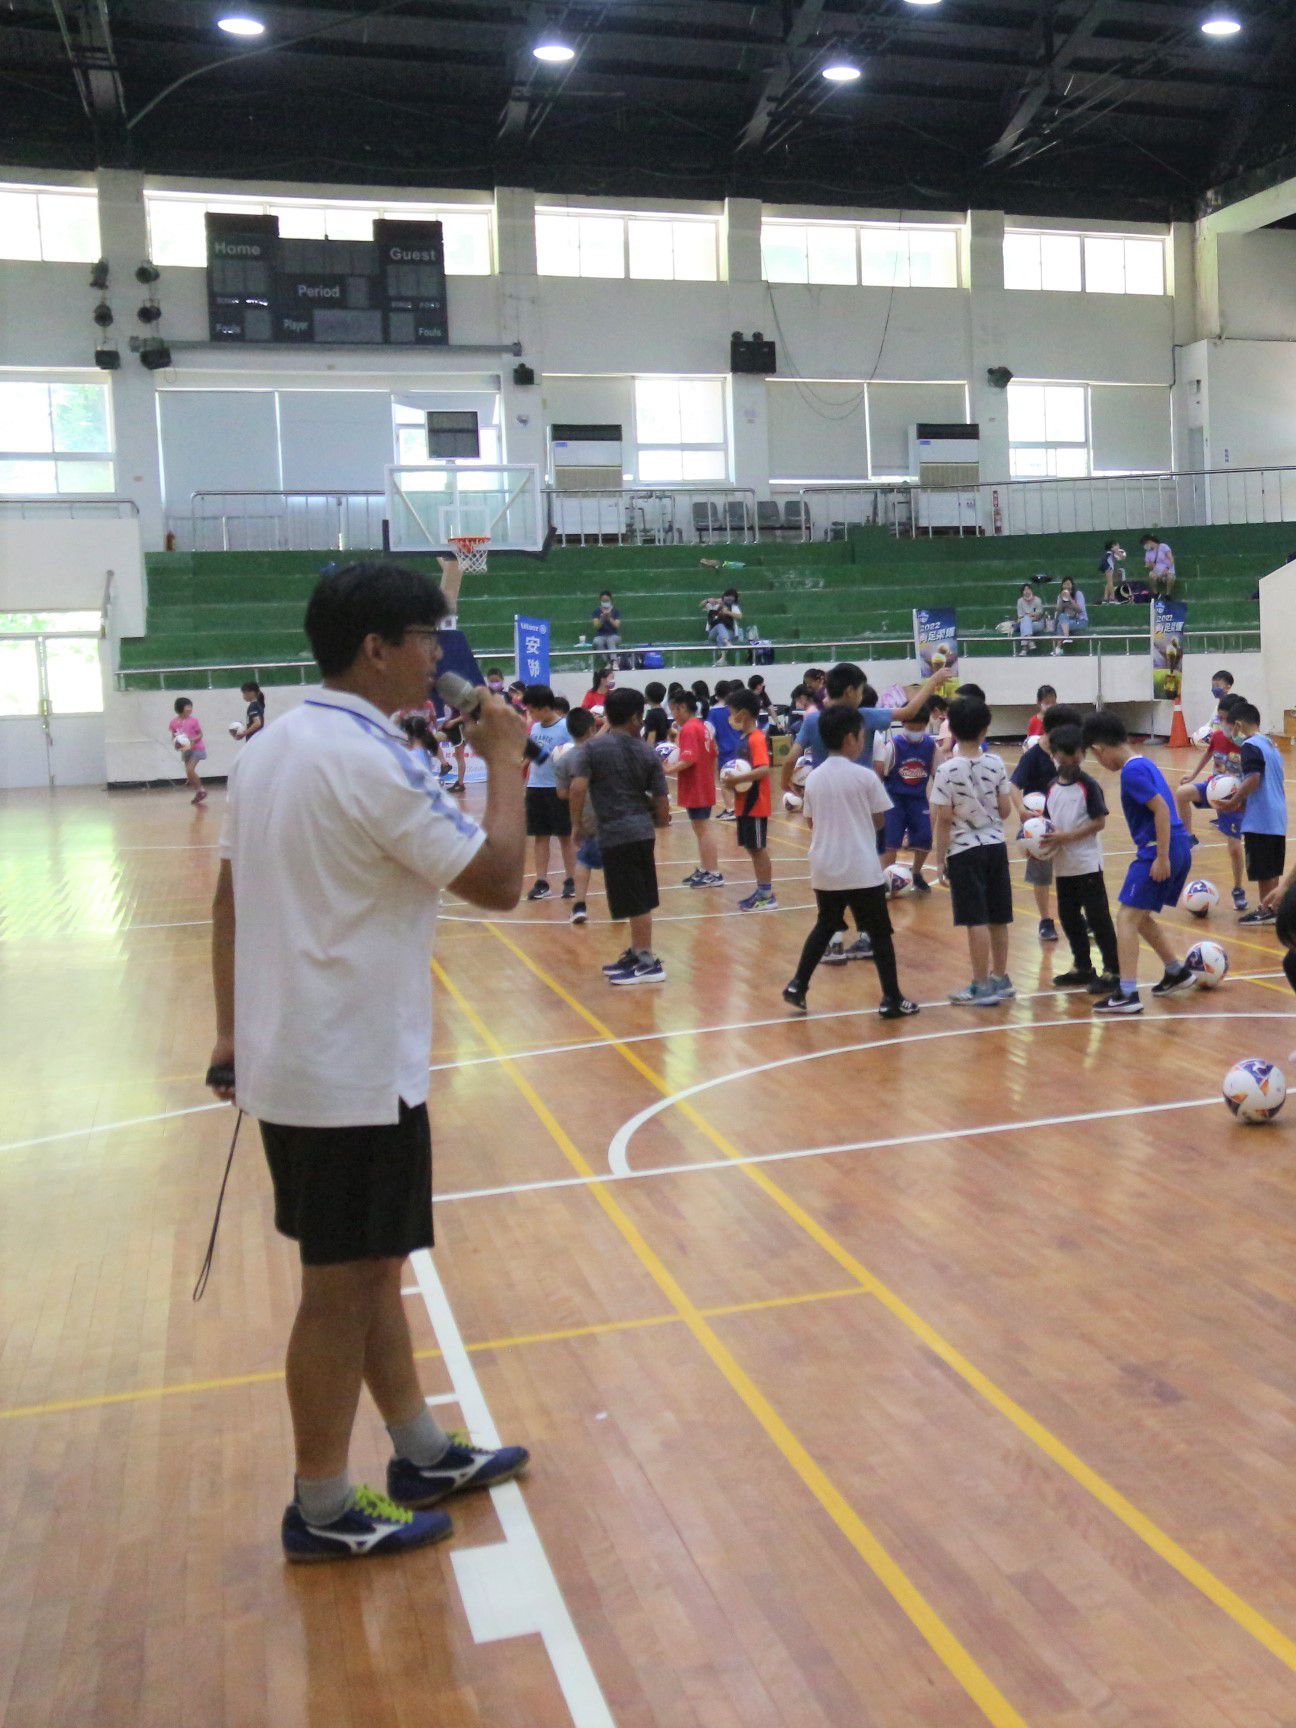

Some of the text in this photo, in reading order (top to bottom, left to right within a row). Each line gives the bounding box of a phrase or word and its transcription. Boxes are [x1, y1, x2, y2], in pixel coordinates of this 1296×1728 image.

[214, 242, 261, 256] Home
[389, 248, 436, 262] Guest
[298, 284, 340, 299] Period
[418, 327, 442, 337] Fouls
[920, 621, 941, 632] 2022
